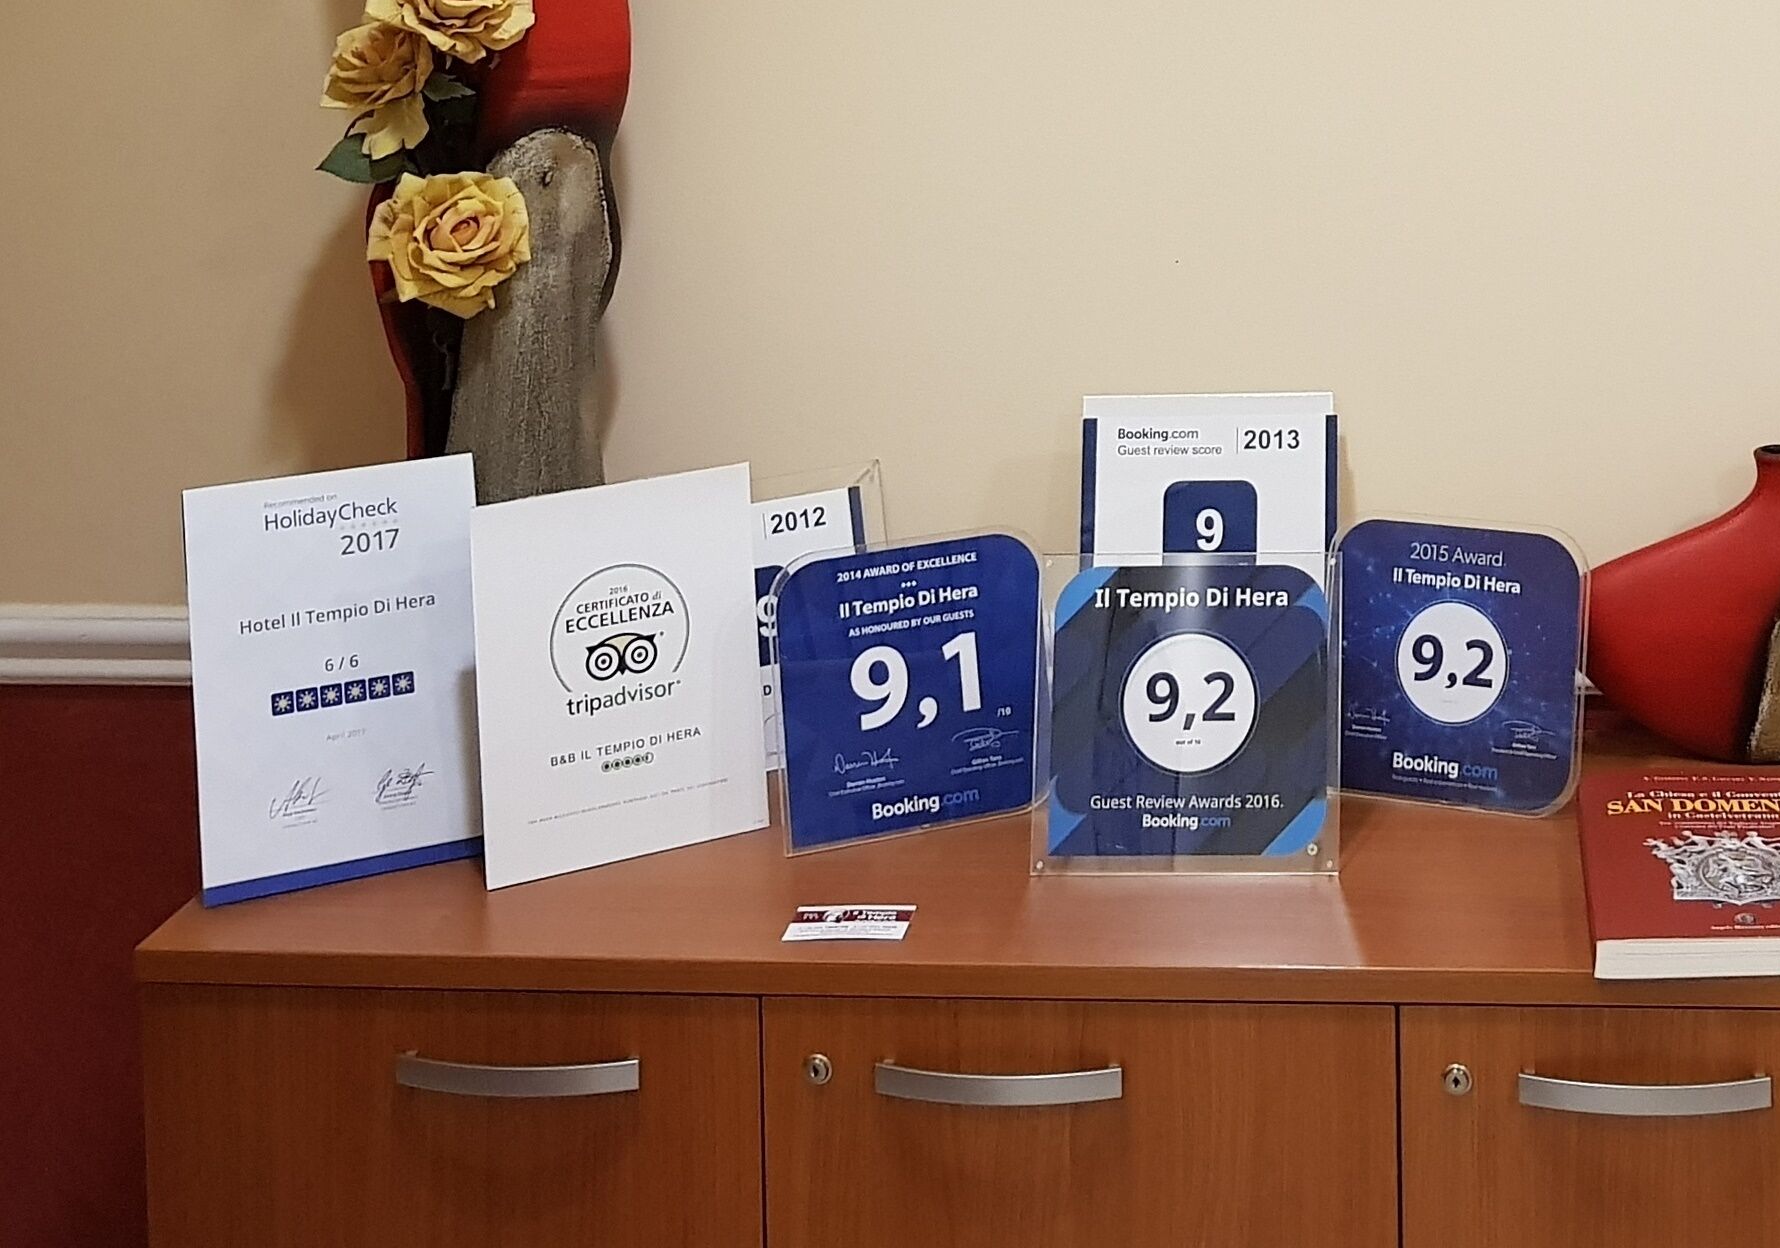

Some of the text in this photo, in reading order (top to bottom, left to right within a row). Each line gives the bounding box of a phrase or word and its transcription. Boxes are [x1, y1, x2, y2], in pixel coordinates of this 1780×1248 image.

[1117, 428, 1199, 441] Booking.com
[1243, 429, 1300, 450] 2013
[1117, 445, 1222, 455] Guest review score
[264, 497, 398, 531] HolidayCheck
[770, 506, 827, 534] 2012
[340, 528, 399, 556] 2017
[1195, 508, 1224, 551] 9
[1410, 542, 1449, 562] 2015
[837, 552, 977, 583] 2014 AWARD OF EXCELLENCE
[609, 585, 628, 595] 2016
[1406, 569, 1460, 589] Tempio
[1464, 574, 1480, 589] Di
[1483, 578, 1521, 595] Hera
[240, 594, 436, 634] Hotel Il Tempio Di Hera
[576, 591, 662, 614] CERTIFICATO di
[839, 586, 978, 618] Il Tempio Di Hera
[1094, 588, 1288, 613] Il Tempio Di Hera
[565, 601, 674, 633] ECCELLENZA
[849, 609, 975, 637] AS HONOURED BY OUR GUESTS
[325, 658, 334, 672] 6
[350, 655, 359, 668] 6
[1412, 634, 1494, 689] 9,2
[850, 632, 981, 731] 9,1
[566, 681, 676, 716] tripadvisor
[1146, 671, 1235, 731] 9,2
[550, 726, 701, 767] B&B IL TEMPIO DI HERA
[1392, 751, 1498, 780] Booking.com
[872, 789, 980, 821] Booking.com
[1090, 794, 1284, 809] Guest Review Awards 2016.
[1607, 798, 1663, 815] SAN
[1649, 791, 1695, 799] Chiesa
[1142, 814, 1231, 830] Booking.com
